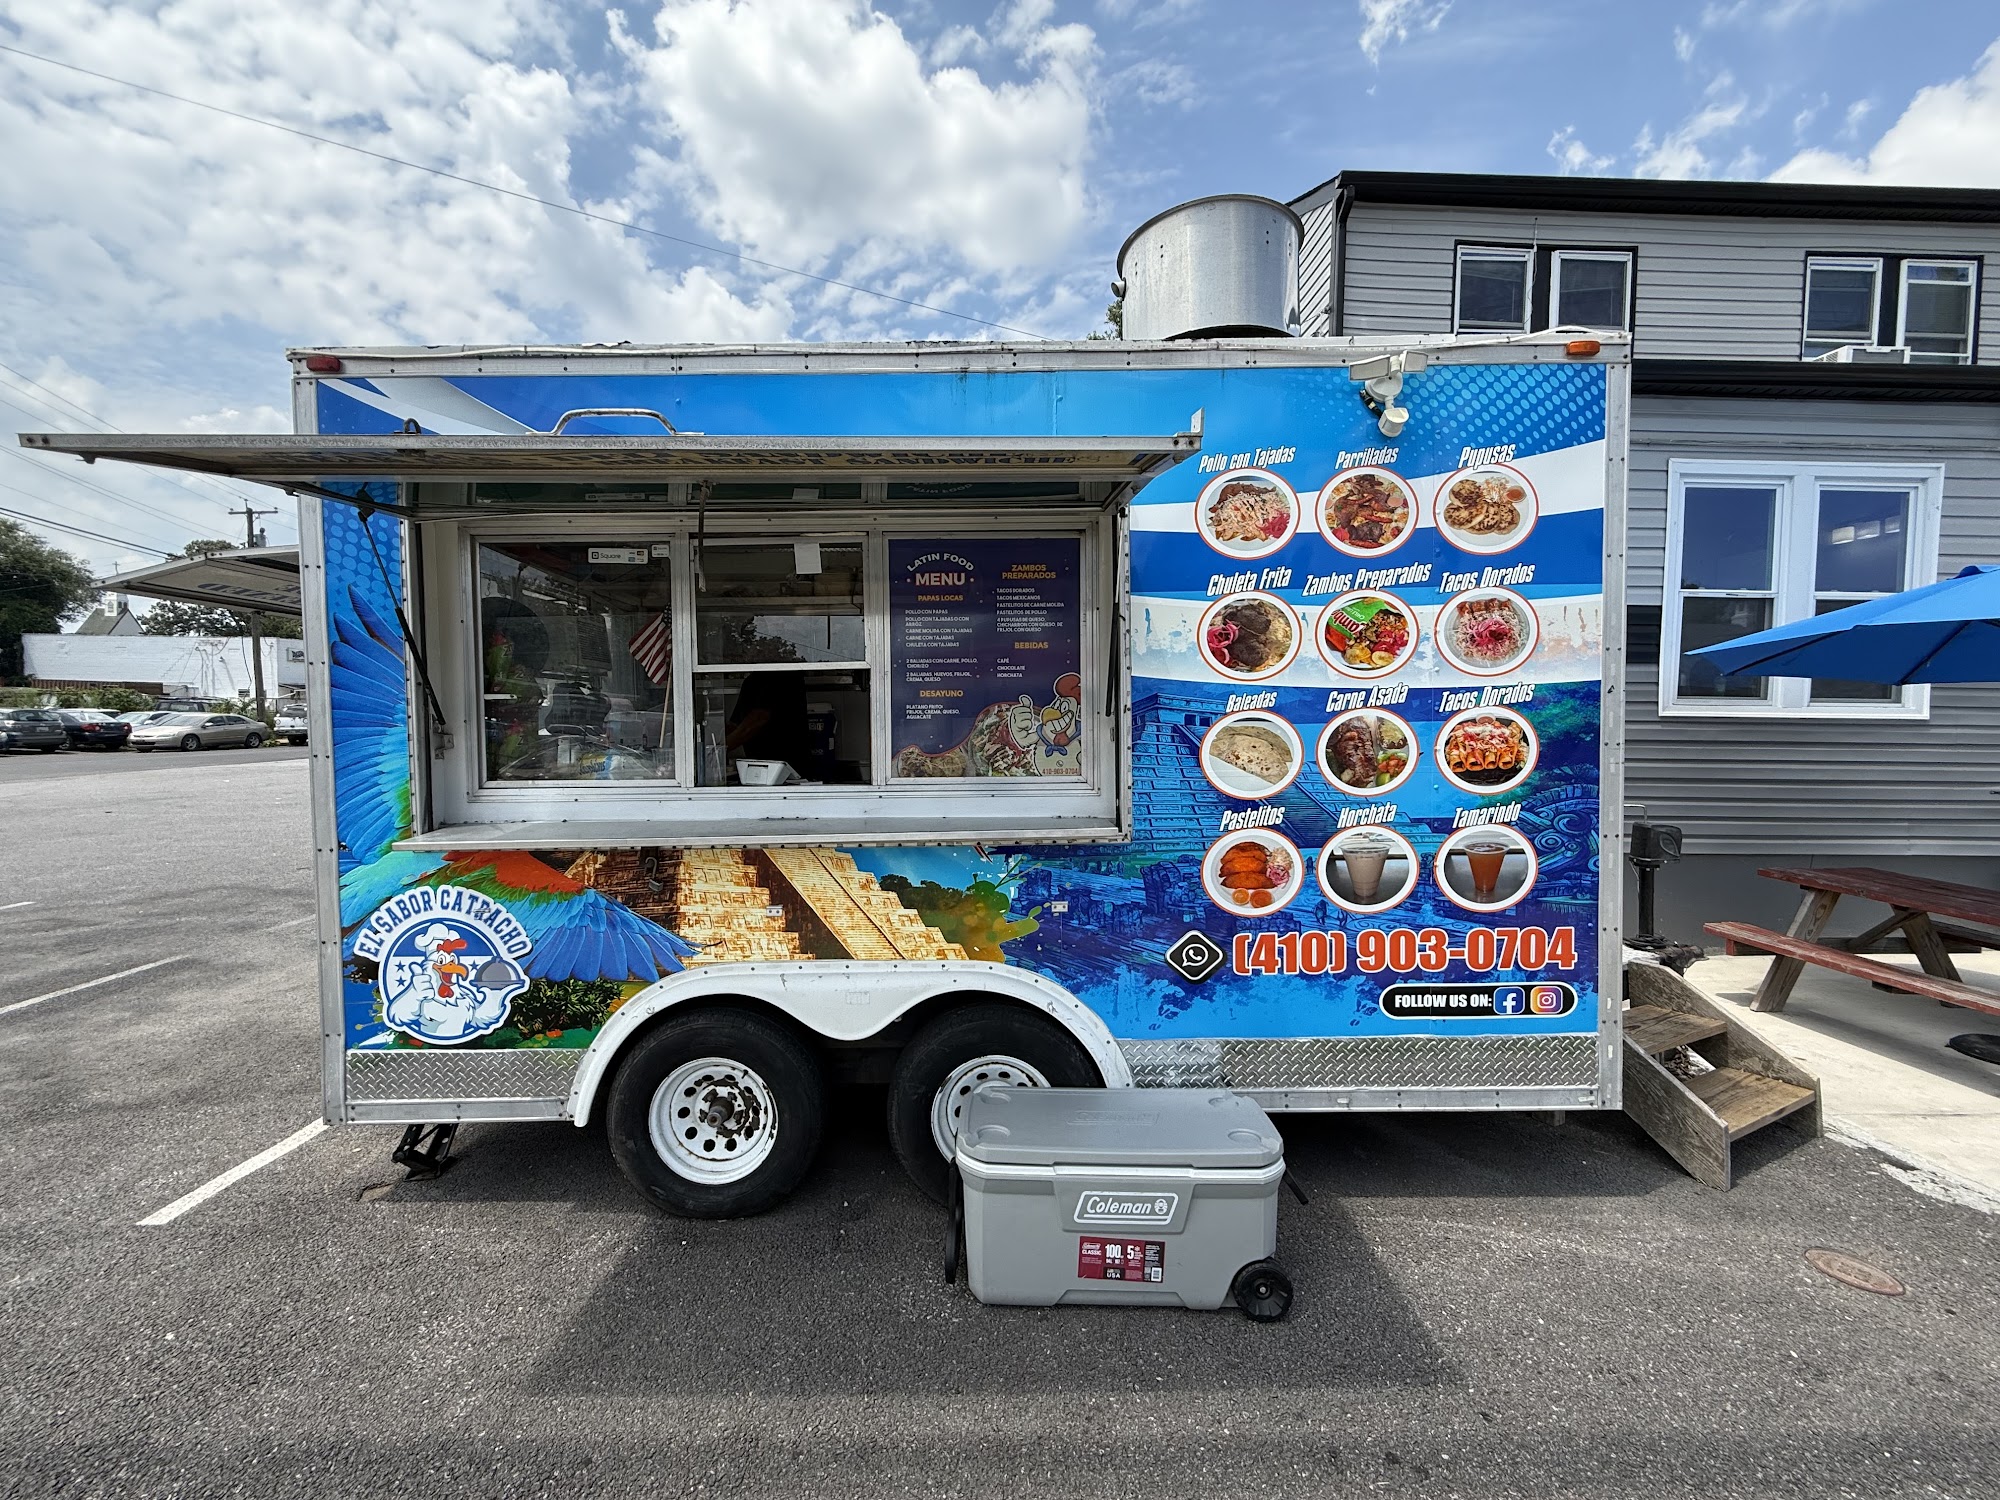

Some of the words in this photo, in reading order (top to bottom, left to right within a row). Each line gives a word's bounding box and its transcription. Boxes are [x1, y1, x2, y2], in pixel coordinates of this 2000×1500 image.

[1198, 452, 1228, 474] Pollo
[1229, 453, 1248, 470] con
[1249, 445, 1295, 468] Tajadas
[1334, 444, 1399, 470] Parrilladas
[1458, 442, 1516, 470] Pupusas
[600, 552, 621, 560] Square
[906, 552, 940, 572] LATIN
[943, 553, 974, 571] FOOD
[1002, 571, 1056, 580] PREPARADOS
[1011, 564, 1046, 572] ZAMBOS
[1439, 569, 1478, 594] Tacos
[1479, 562, 1536, 589] Dorados
[915, 572, 966, 586] MENU
[1206, 569, 1258, 596] Chuleta
[1259, 565, 1292, 589] Frita
[1302, 571, 1353, 597] Zambos
[1353, 561, 1432, 593] Preparados
[918, 594, 940, 602] PAPAS
[940, 594, 963, 602] LOCAS
[1014, 641, 1049, 649] BEBIDAS
[920, 690, 964, 698] DESAYUNO
[1225, 692, 1277, 713] Baleadas
[1325, 688, 1368, 713] Carne
[1368, 682, 1409, 706] Asada
[1438, 689, 1478, 713] Tacos
[1479, 683, 1535, 708] Dorados
[1042, 767, 1078, 775] 410-903-0704
[1219, 804, 1285, 832] Pastelitos
[1336, 801, 1397, 829] Horchata
[1451, 800, 1521, 830] Tamarindo
[357, 932, 385, 958] EL
[372, 889, 434, 933] SABOR
[440, 889, 528, 955] CATRACHO
[1232, 929, 1349, 977] (410)
[1356, 926, 1578, 972] 903-0704
[1394, 993, 1447, 1009] FOLLOW
[1449, 993, 1468, 1008] US
[1469, 993, 1492, 1008] ON:
[1086, 1196, 1151, 1214] Coleman
[1105, 1244, 1122, 1258] 100
[1126, 1245, 1135, 1259] 5
